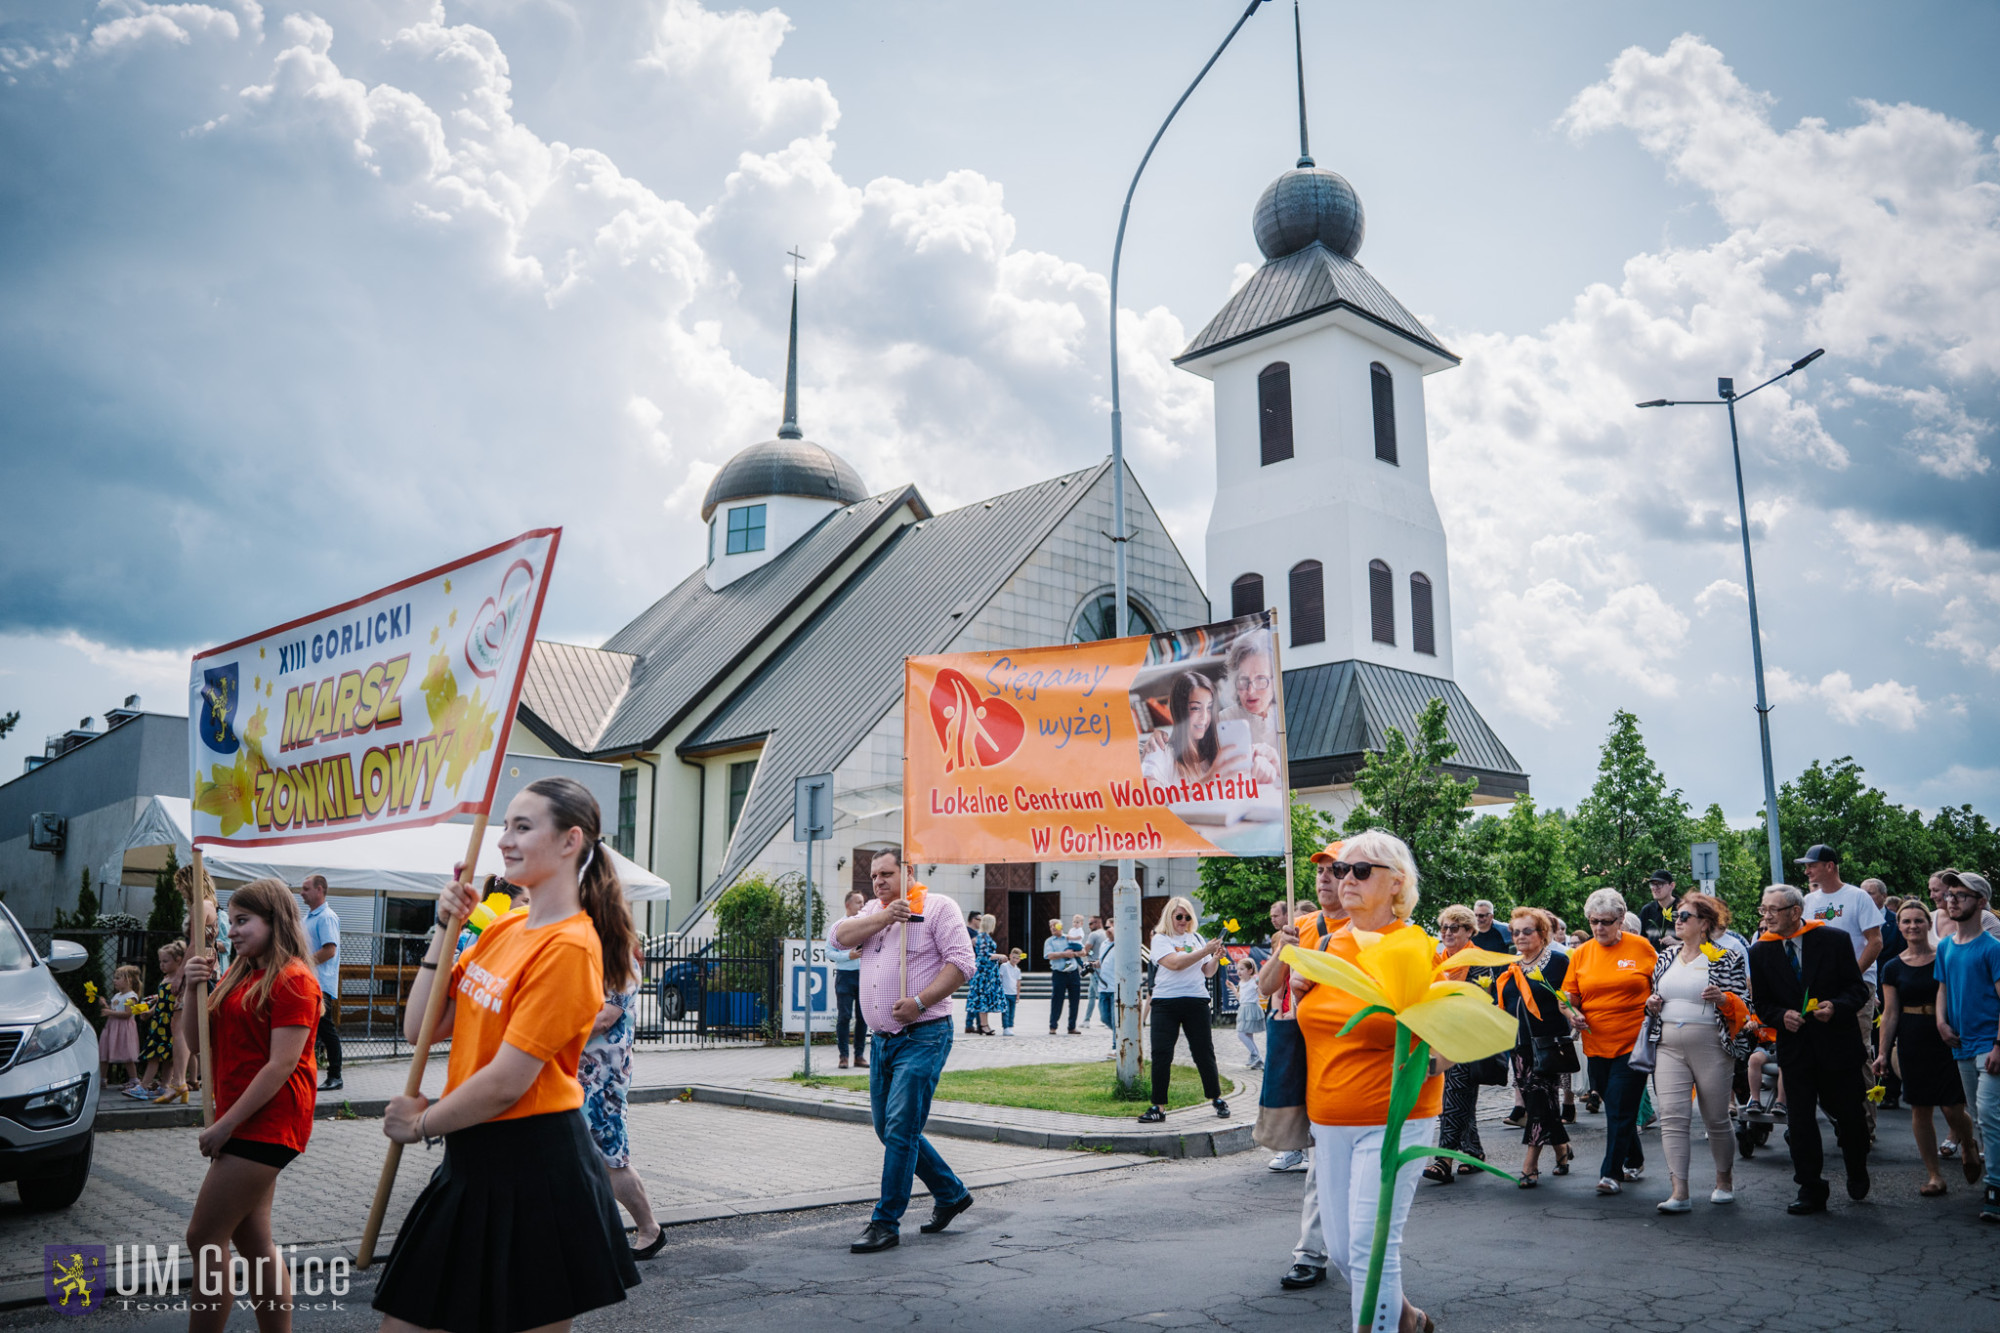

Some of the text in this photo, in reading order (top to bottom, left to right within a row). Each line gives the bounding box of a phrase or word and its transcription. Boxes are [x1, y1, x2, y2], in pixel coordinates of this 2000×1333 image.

[279, 602, 412, 675] XIII GORLICKI
[985, 656, 1110, 701] Sięgamy
[280, 653, 412, 753] MARSZ
[1039, 702, 1111, 749] wyżej
[254, 728, 456, 832] ŻONKILOWY
[931, 772, 1259, 815] Lokalne Centrum Wolontariatu
[1032, 822, 1162, 854] W Gorlicach
